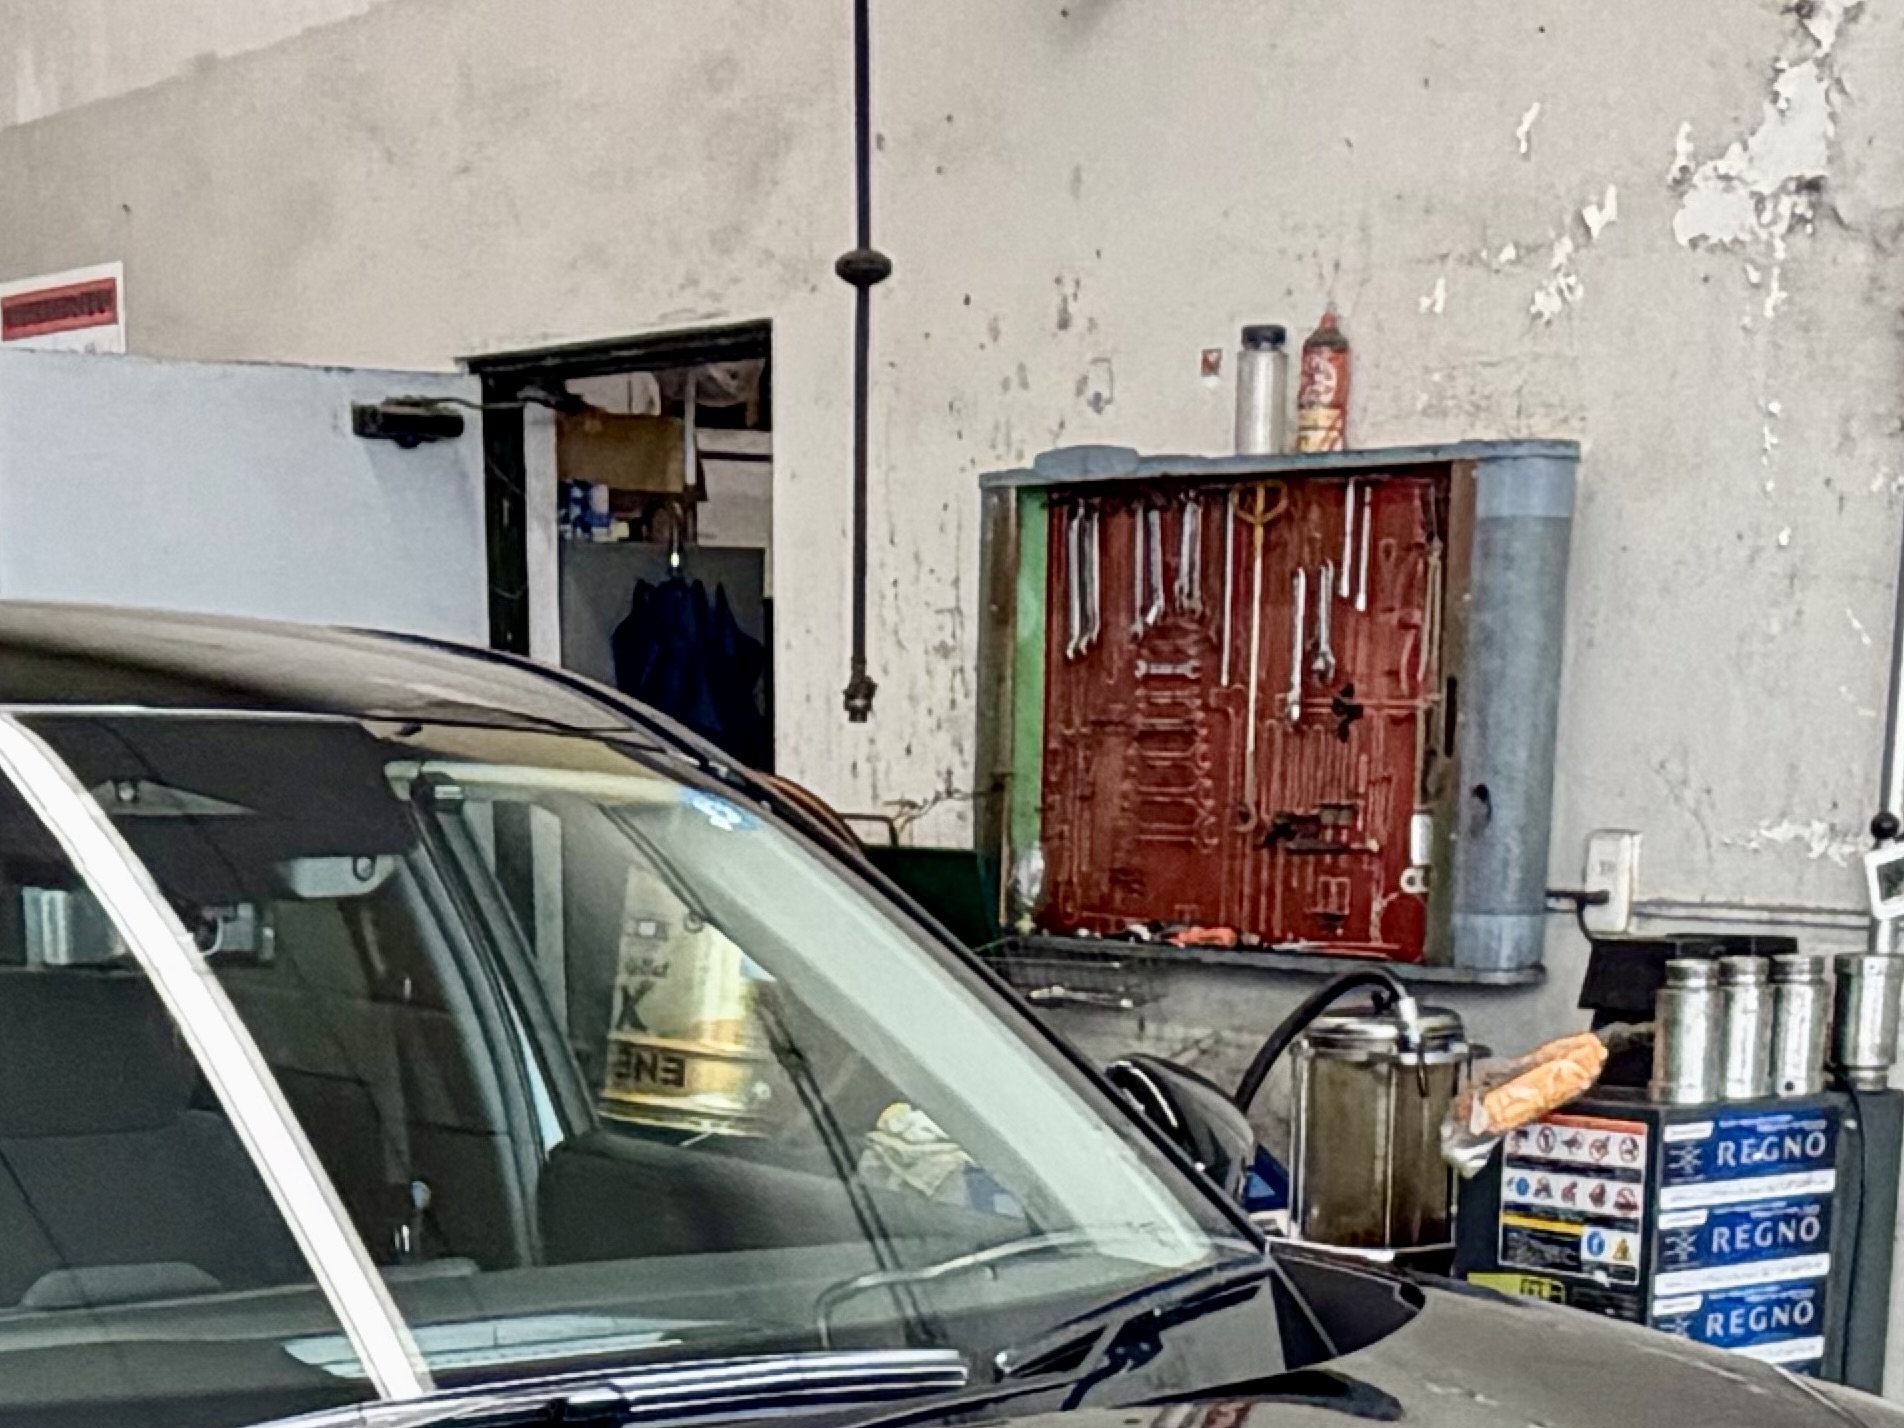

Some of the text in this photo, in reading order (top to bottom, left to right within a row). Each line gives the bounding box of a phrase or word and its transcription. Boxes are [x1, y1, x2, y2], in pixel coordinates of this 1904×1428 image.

[1716, 1131, 1827, 1168] REGNO
[1711, 1215, 1821, 1254] REGNO
[1706, 1299, 1814, 1338] REGNO
